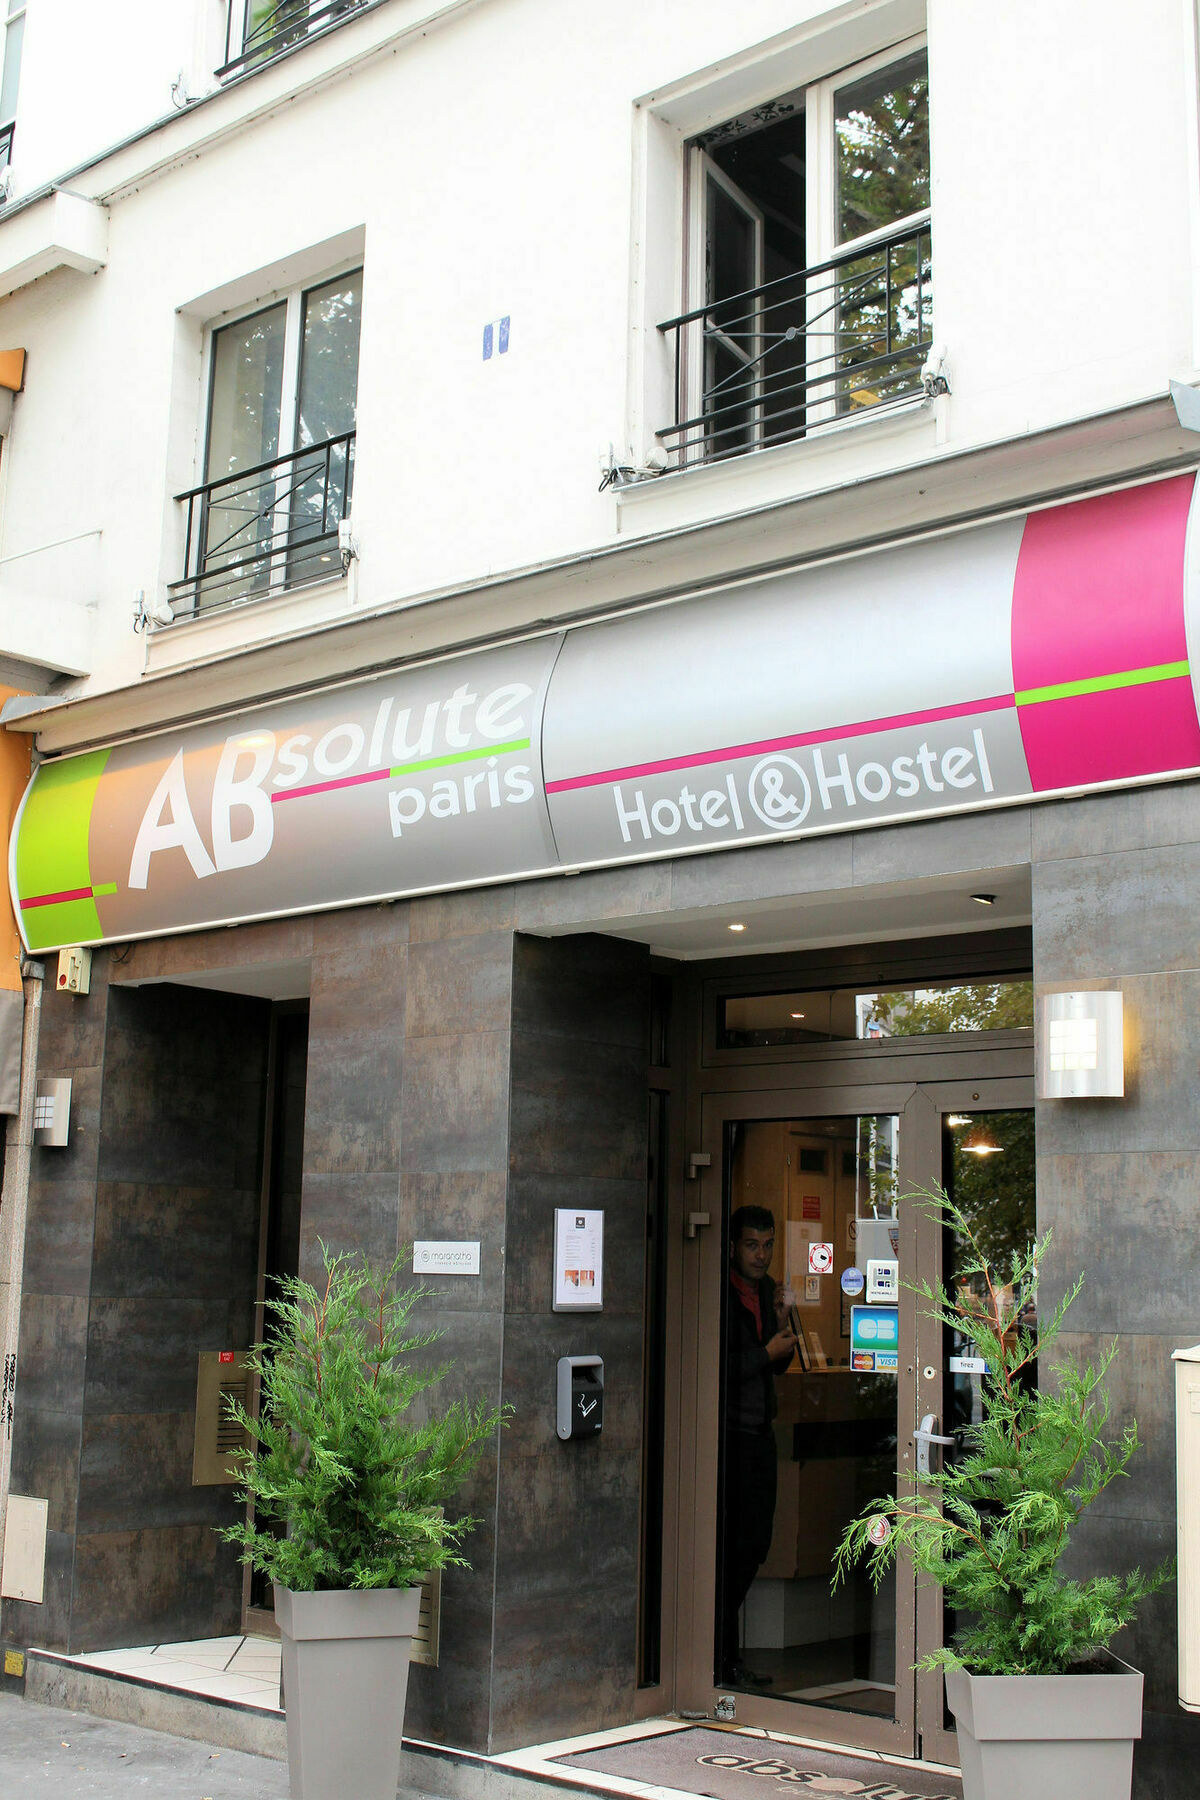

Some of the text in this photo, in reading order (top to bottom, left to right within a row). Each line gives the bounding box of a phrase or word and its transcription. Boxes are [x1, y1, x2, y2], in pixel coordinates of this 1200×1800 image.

[128, 682, 534, 889] ABsolute
[388, 757, 535, 838] paris
[613, 773, 745, 843] Hotel
[811, 727, 995, 811] Hostel
[880, 1358, 897, 1366] VISA
